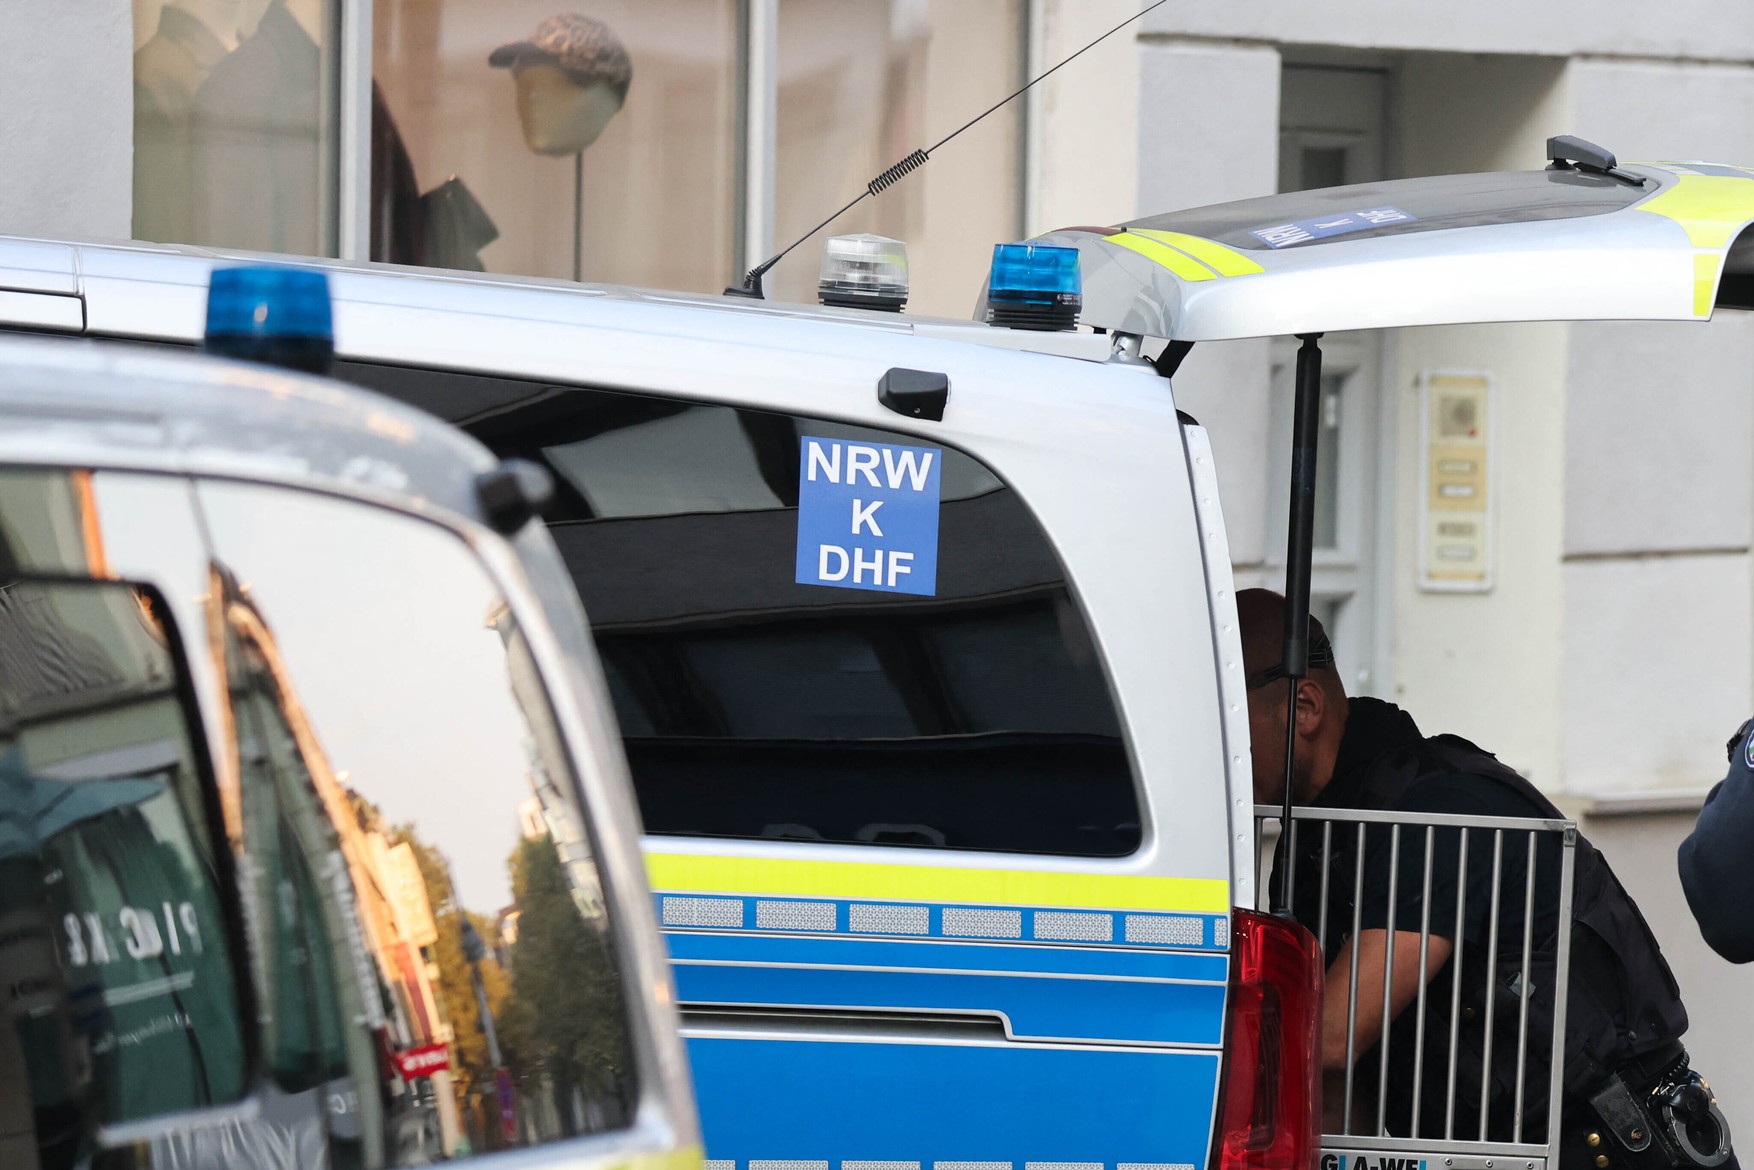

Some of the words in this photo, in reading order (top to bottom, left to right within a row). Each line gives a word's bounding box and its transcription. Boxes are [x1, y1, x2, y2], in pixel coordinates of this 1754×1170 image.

[807, 441, 934, 492] NRW
[851, 498, 885, 537] K
[818, 543, 914, 587] DHF
